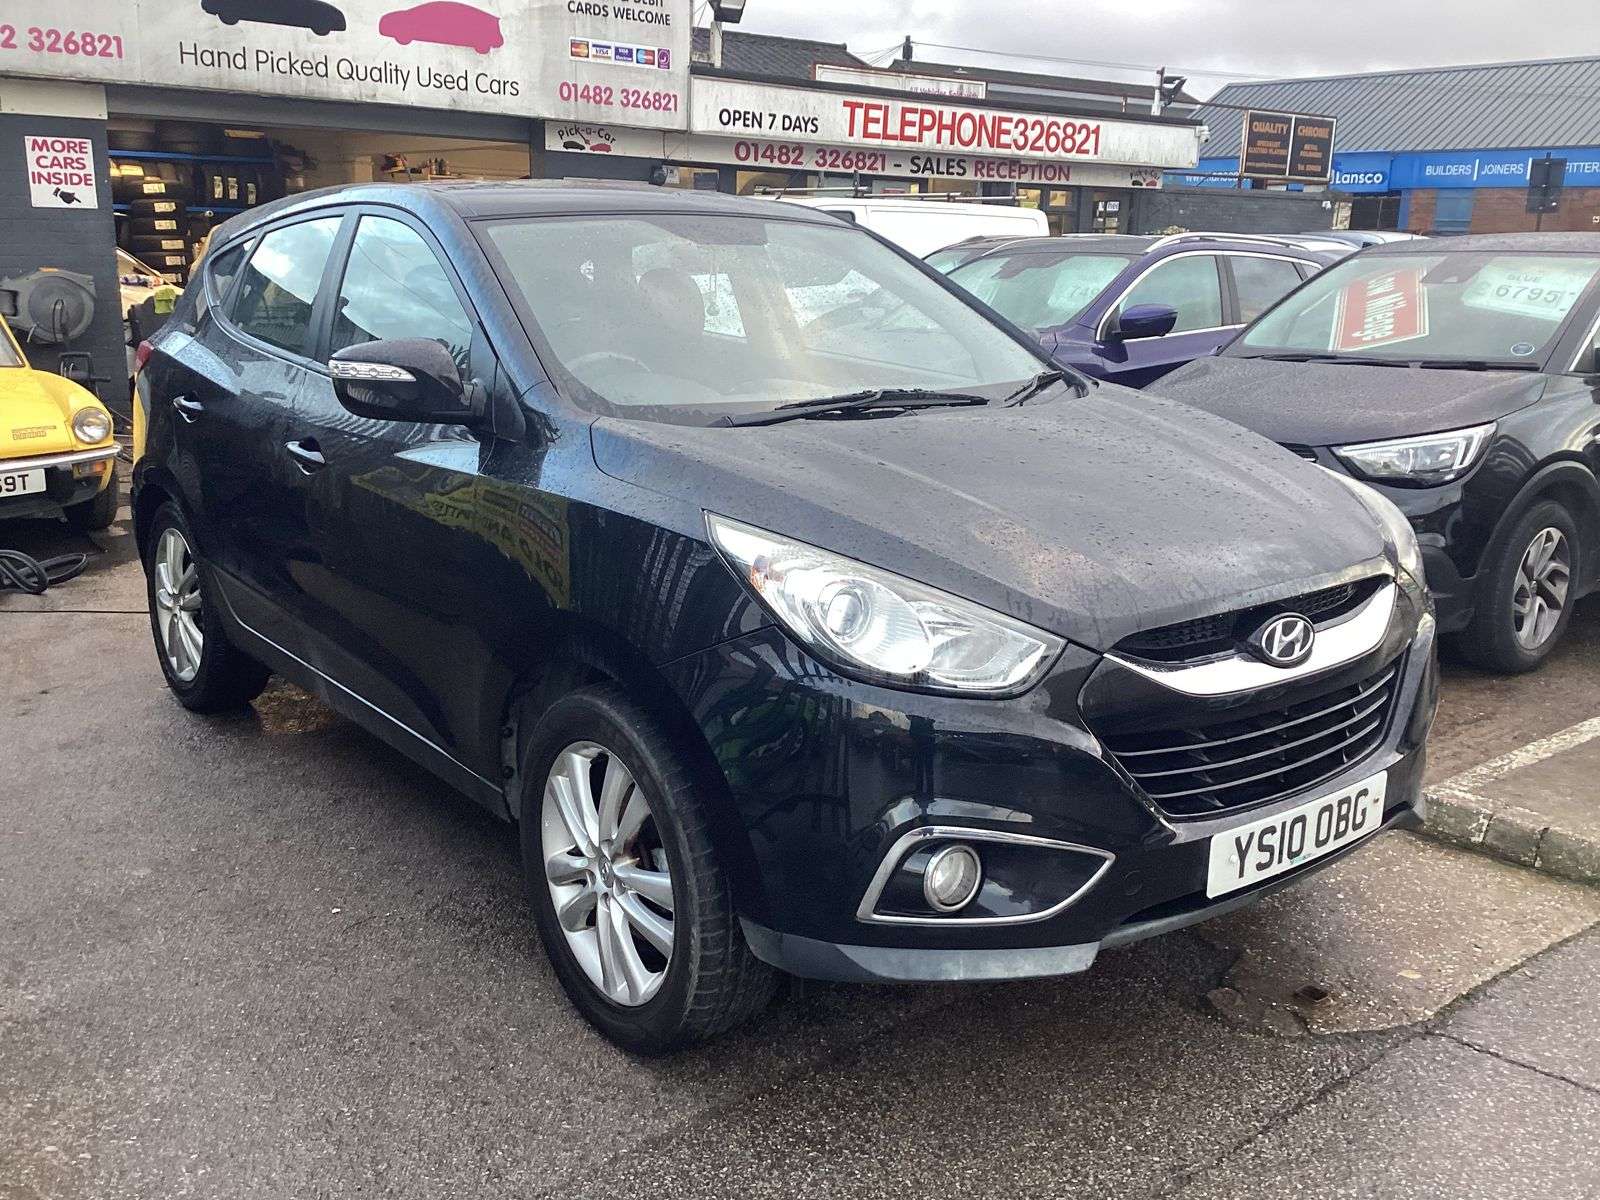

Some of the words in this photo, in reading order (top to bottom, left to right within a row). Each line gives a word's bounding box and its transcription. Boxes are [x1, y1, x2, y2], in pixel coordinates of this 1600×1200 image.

[567, 1, 609, 17] CARDS
[613, 6, 671, 26] WELCOME
[28, 27, 123, 59] 326821
[179, 41, 247, 70] Hand
[255, 49, 329, 78] Picked
[336, 58, 411, 91] Quality
[416, 66, 468, 91] Used
[474, 73, 520, 96] Cars
[559, 81, 614, 106] 01482
[620, 88, 678, 112] 326821
[719, 108, 763, 129] OPEN
[768, 113, 777, 130] 7
[782, 115, 819, 134] DAYS
[1252, 121, 1289, 135] QUALITY
[31, 139, 89, 155] MORE
[36, 155, 87, 171] CARS
[734, 140, 804, 166] 01482
[815, 148, 887, 171] 326821
[910, 155, 967, 177] SALES
[974, 159, 1073, 182] RECEPTION
[1425, 165, 1472, 176] BUILDERS
[1481, 163, 1524, 175] JOINERS
[32, 172, 94, 187] INSIDE
[0, 473, 29, 493] 9T
[1234, 814, 1307, 879] YS10
[1314, 787, 1369, 849] OBG
